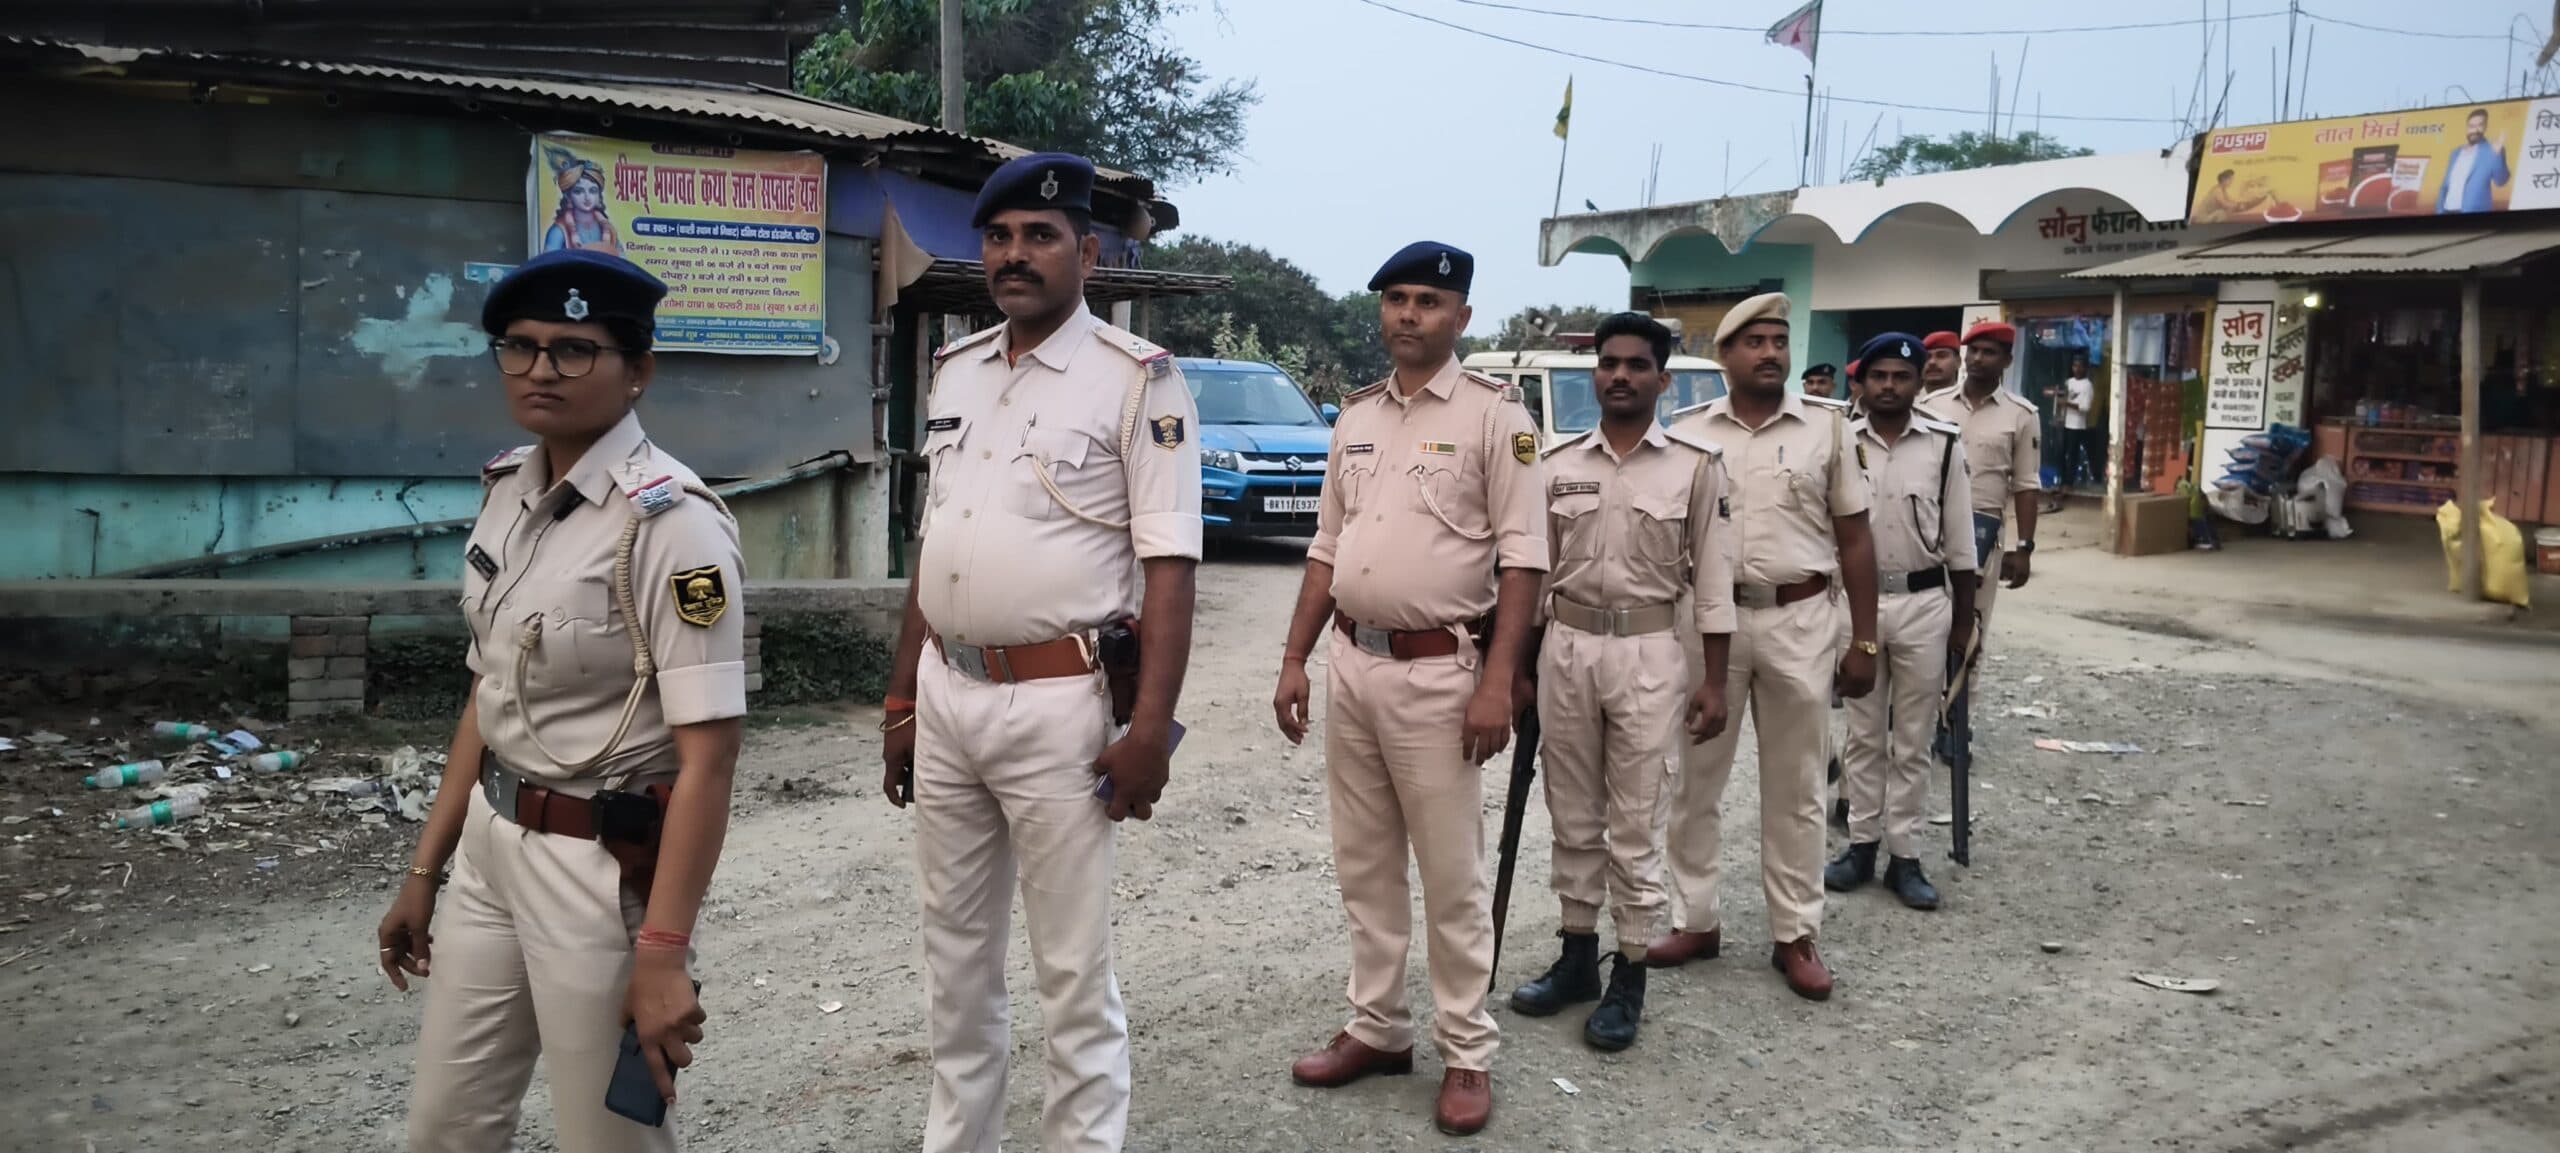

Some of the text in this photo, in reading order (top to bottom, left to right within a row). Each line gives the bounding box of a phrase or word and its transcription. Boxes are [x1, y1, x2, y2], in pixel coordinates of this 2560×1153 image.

[2214, 133, 2265, 149] PUSHP
[2315, 126, 2354, 143] लाल
[614, 152, 819, 214] श्रीमद् भागवत कथा ज्ञान सप्ताह यज्ञ
[1269, 499, 1320, 510] BR11E937
